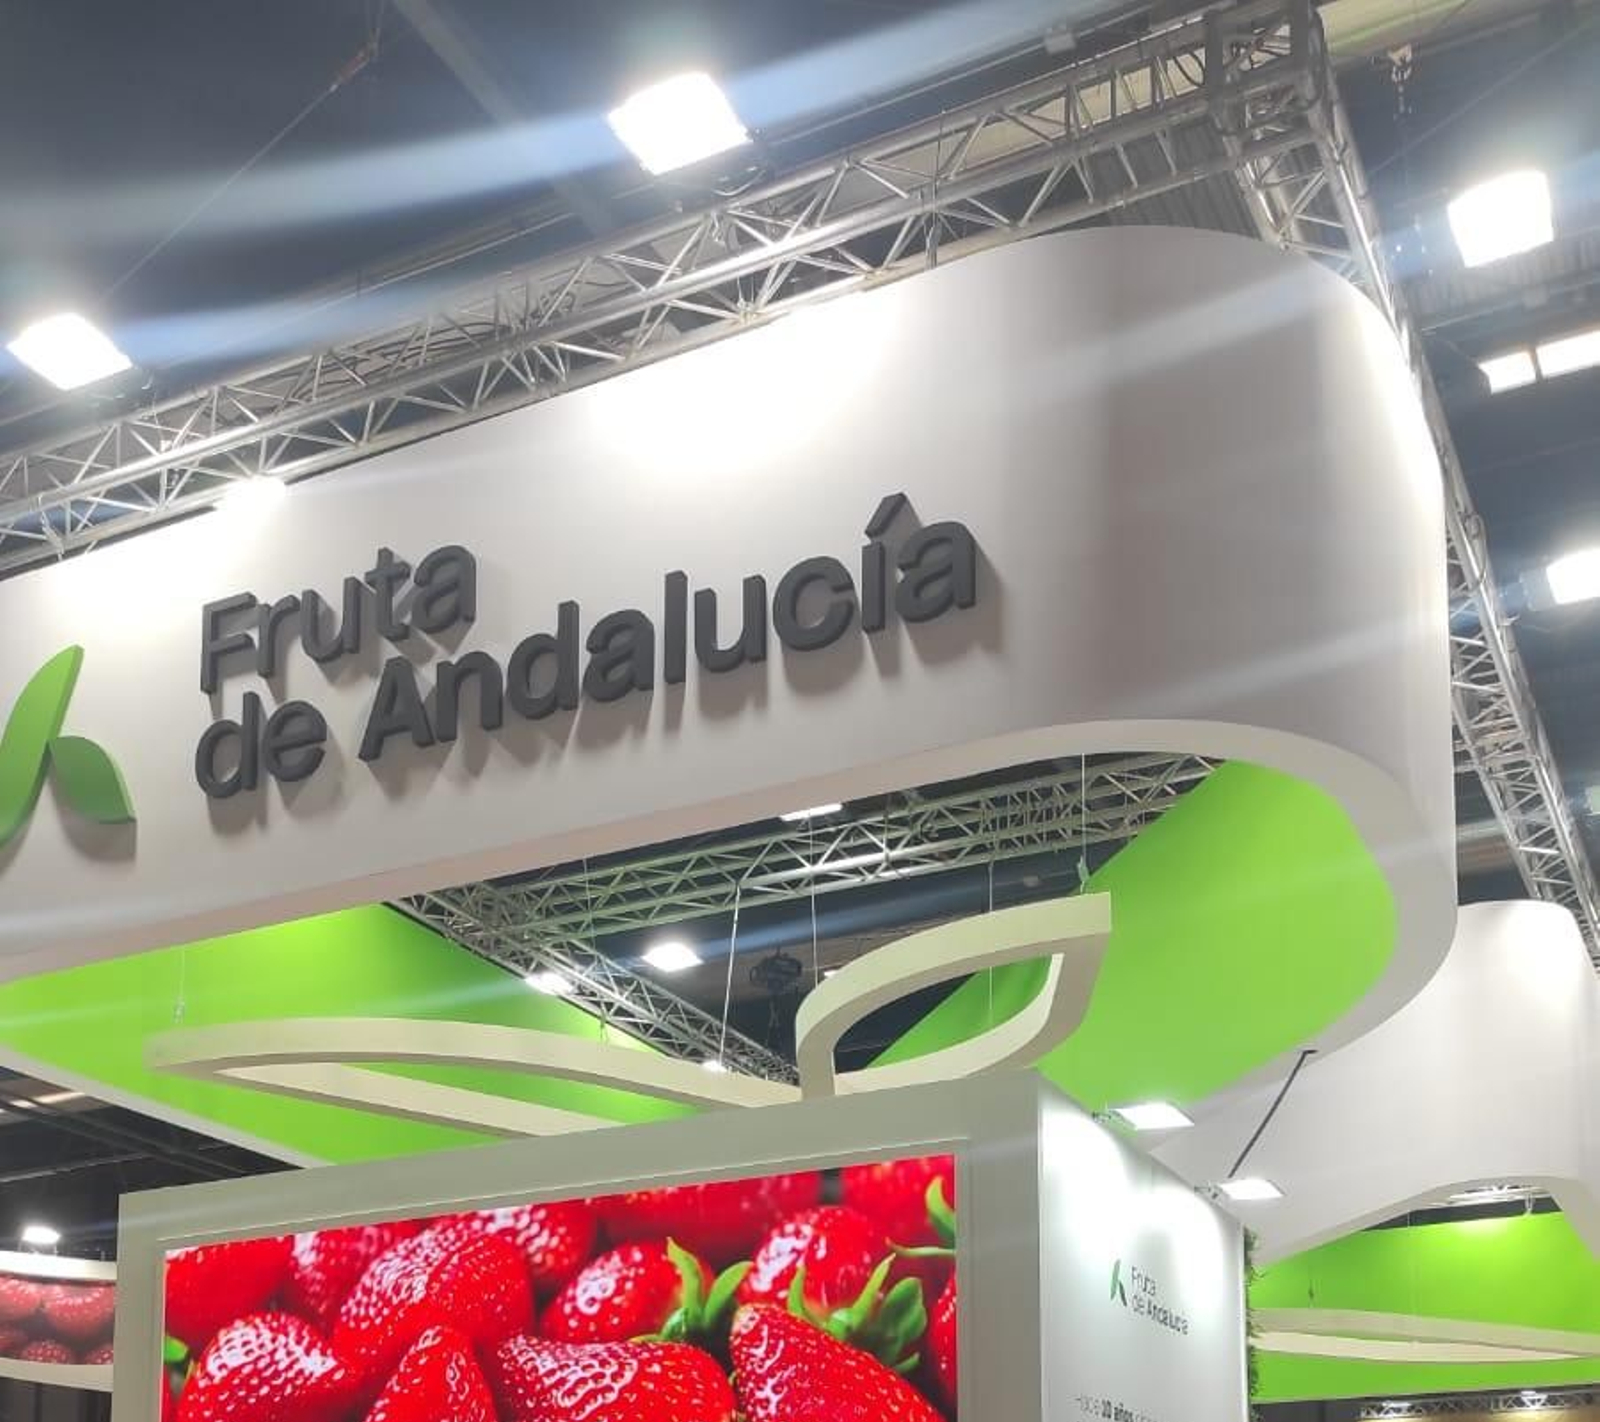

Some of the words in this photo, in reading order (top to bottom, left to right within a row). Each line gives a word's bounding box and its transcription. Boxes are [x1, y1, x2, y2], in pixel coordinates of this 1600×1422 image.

[194, 690, 328, 797] de
[358, 491, 979, 762] Andalucía
[200, 543, 477, 694] Fruta
